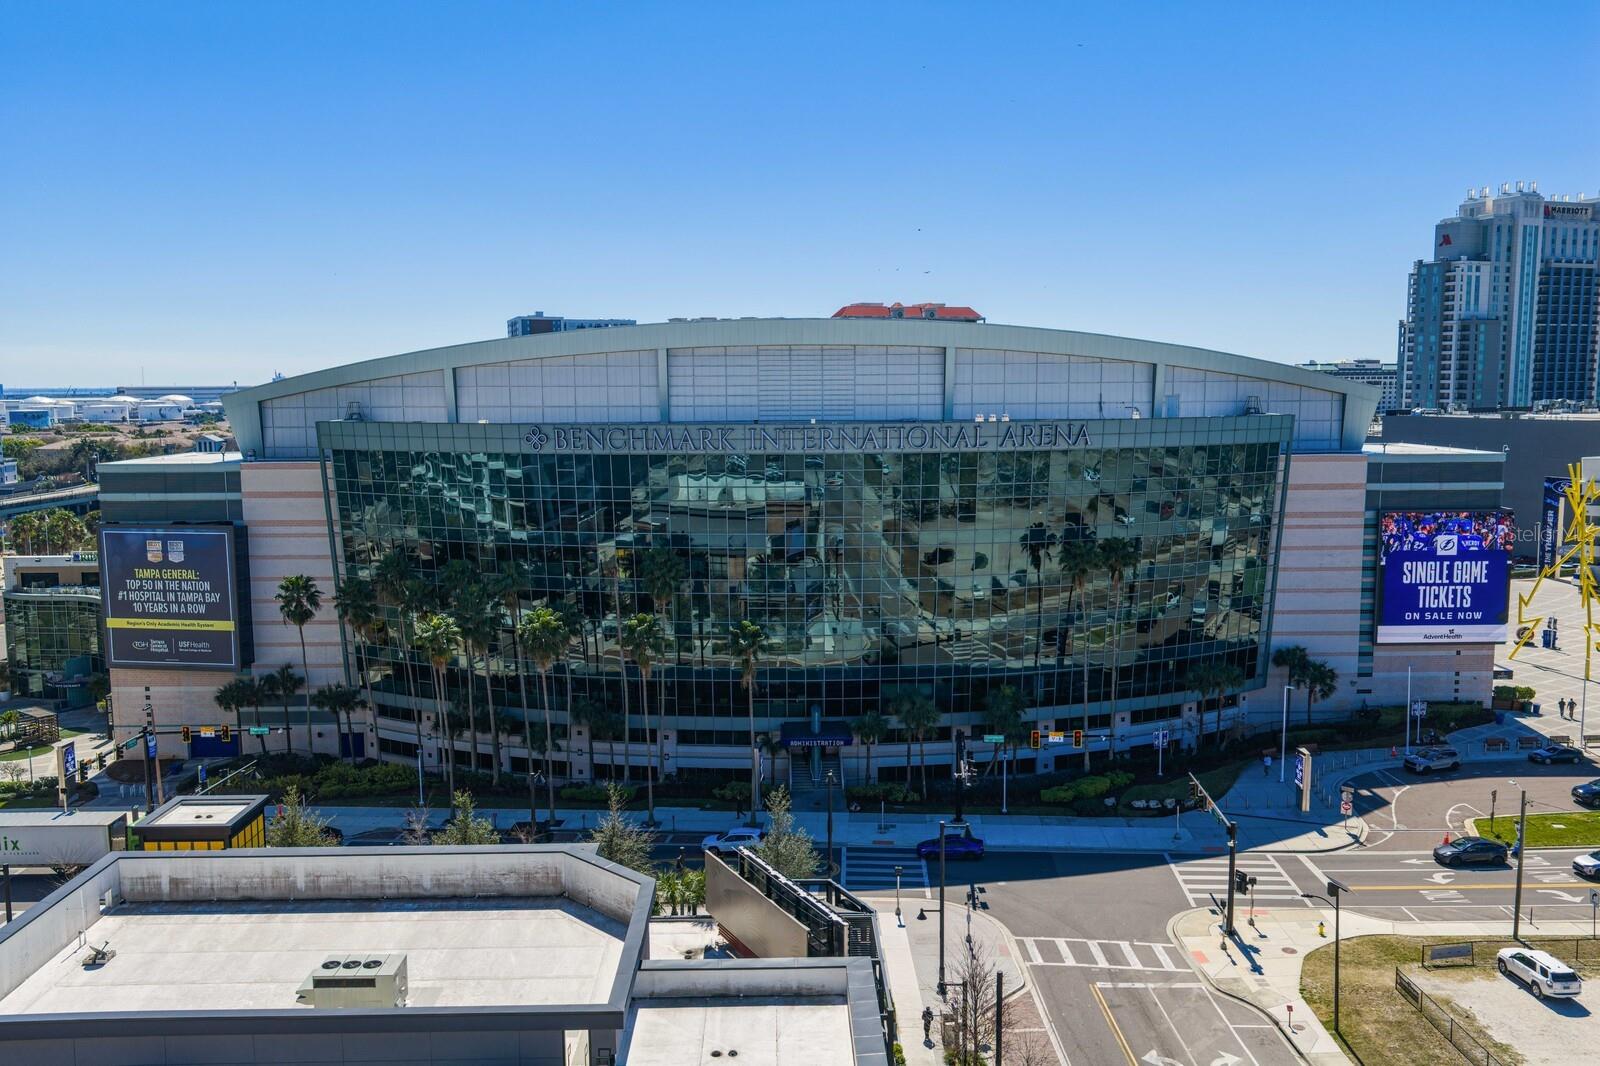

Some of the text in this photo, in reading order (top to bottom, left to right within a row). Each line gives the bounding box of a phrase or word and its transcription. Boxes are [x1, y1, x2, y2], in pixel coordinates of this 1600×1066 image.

[1551, 206, 1589, 215] MARRIOTT
[553, 424, 1093, 452] BENCHMARK INTERNATIONAL ARENA
[134, 568, 200, 580] TAMPA GENERAL:
[1403, 560, 1489, 584] SINGLE GAME
[126, 579, 210, 591] TOP 50 IN THE NATION
[118, 590, 221, 603] #1 HOSPITAL IN TAMPA BAY
[1418, 585, 1472, 608] TICKETS
[133, 602, 206, 614] 10 YEARS IN A ROW
[1405, 611, 1483, 620] ON SALE NOW
